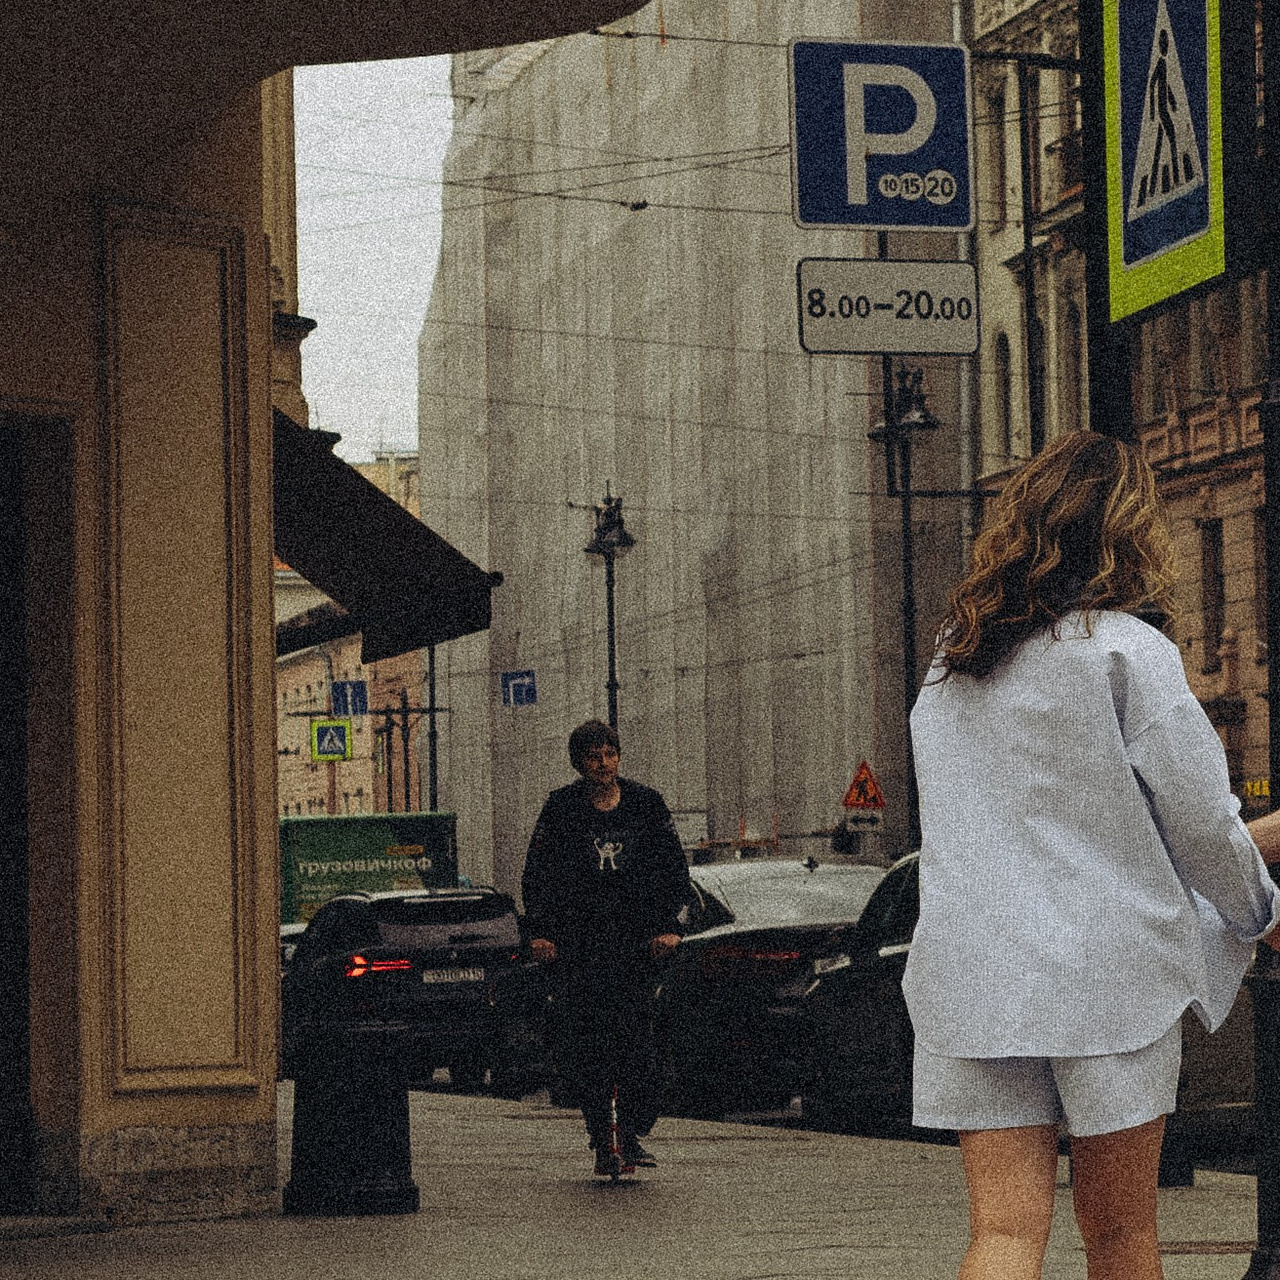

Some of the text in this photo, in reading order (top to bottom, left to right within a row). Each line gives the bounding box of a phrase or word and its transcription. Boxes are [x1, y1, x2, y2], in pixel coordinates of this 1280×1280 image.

[844, 64, 936, 205] P
[883, 177, 953, 197] 10 15 20
[299, 857, 432, 877] грузовичкоф
